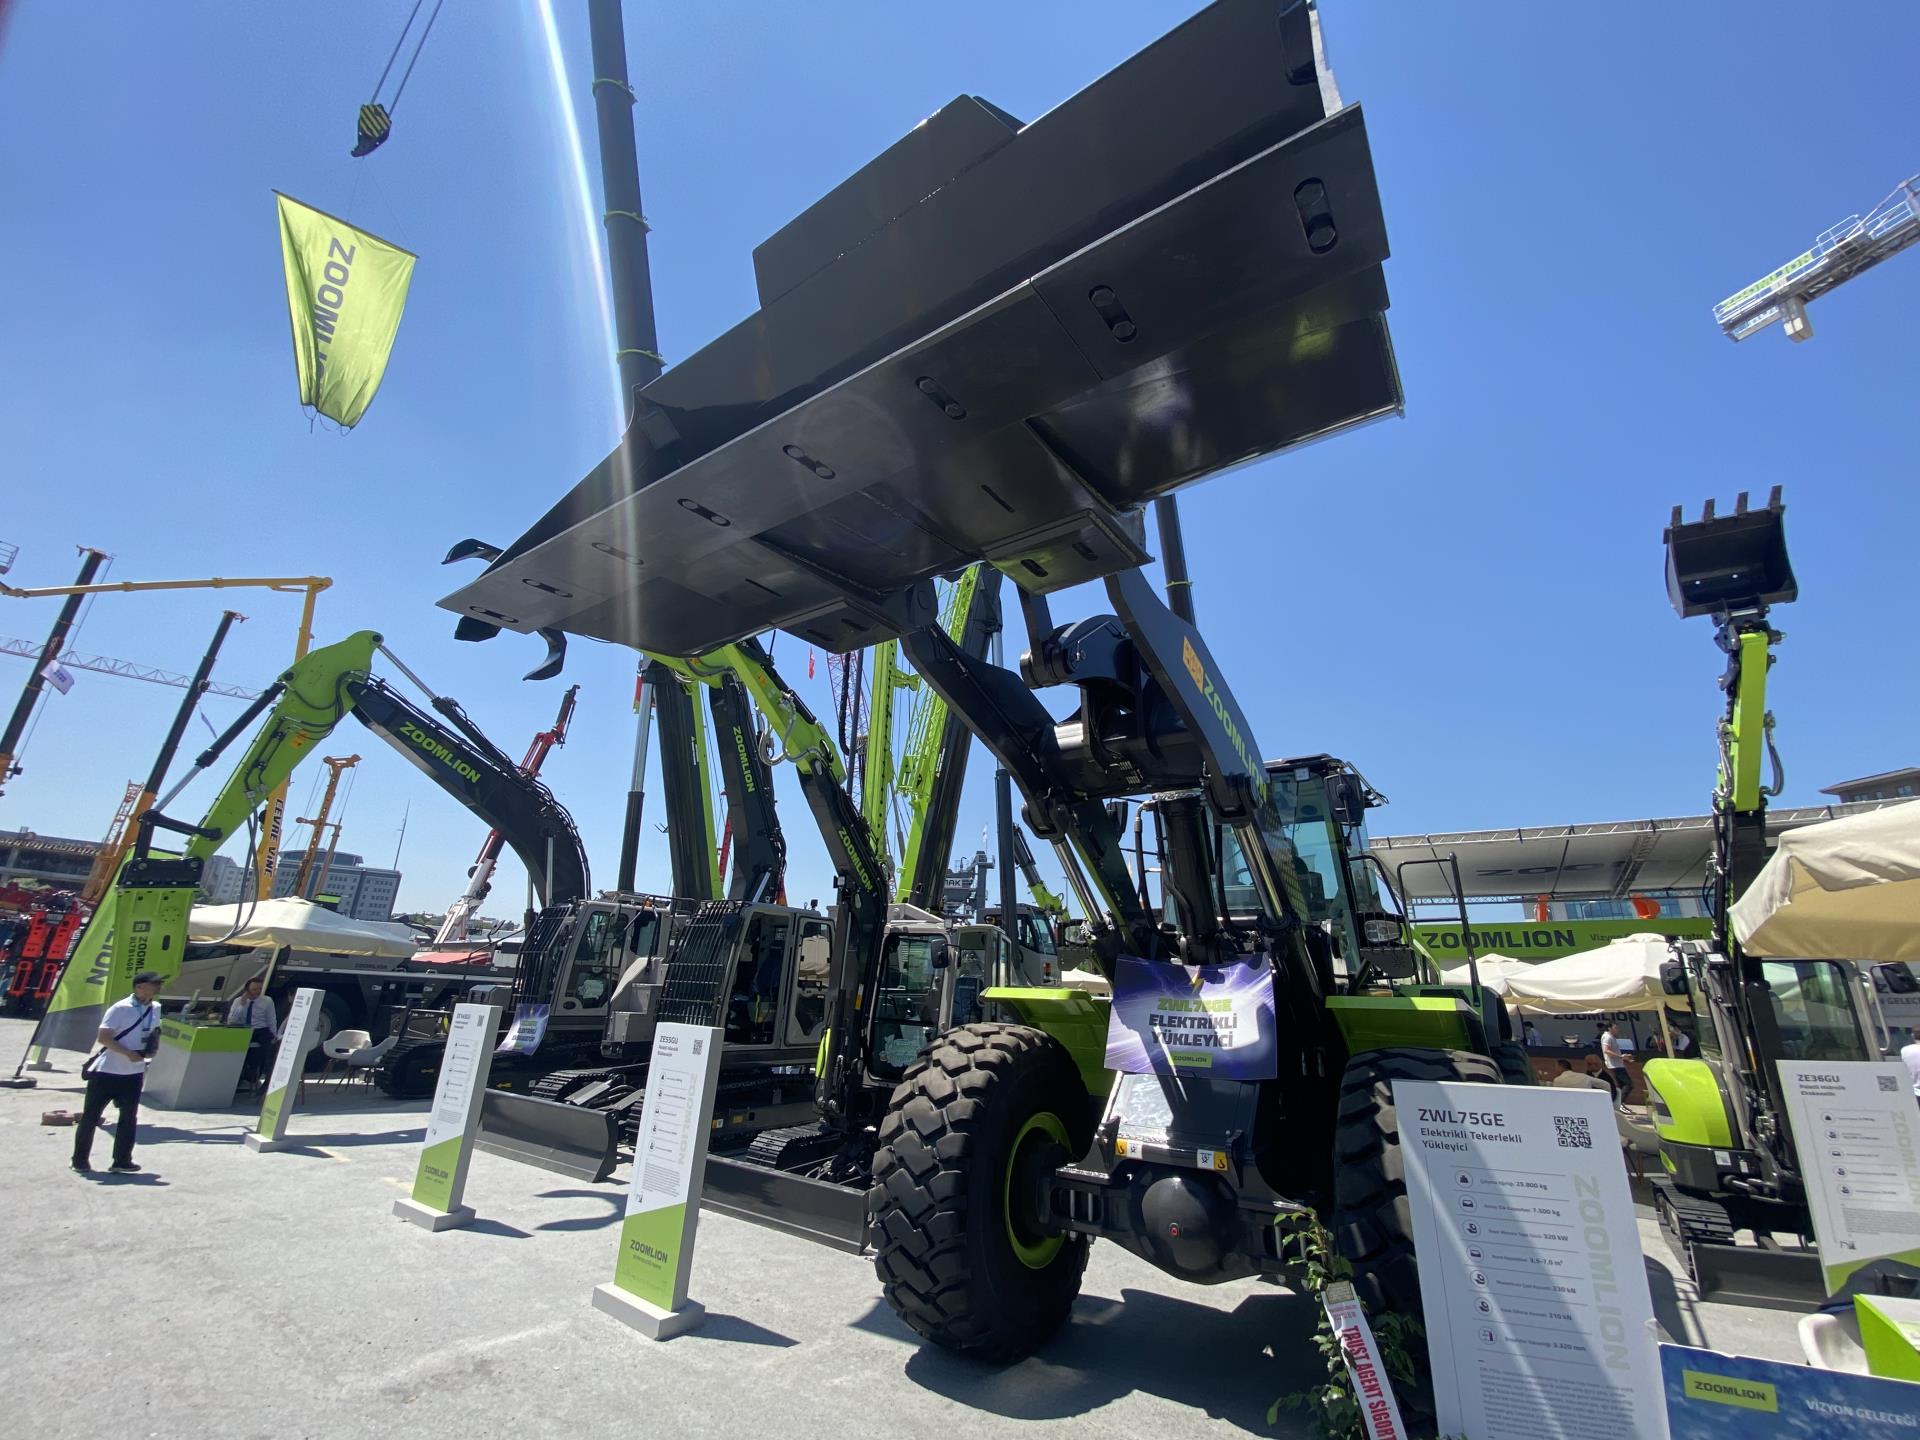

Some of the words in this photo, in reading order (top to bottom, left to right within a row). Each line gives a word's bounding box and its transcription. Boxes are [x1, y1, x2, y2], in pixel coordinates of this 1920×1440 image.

[1204, 672, 1268, 803] ZOOMLION
[399, 721, 481, 783] ZOOMLION
[732, 725, 756, 793] ZOOMLION
[838, 826, 873, 892] ZOOMLION
[1421, 929, 1576, 949] ZOOMLION
[135, 936, 149, 975] ZOOML
[1149, 1013, 1238, 1029] ELEKTRİKLİ
[1152, 1030, 1233, 1047] YÜKLEYİCİ
[1173, 1055, 1207, 1063] ZOOMLION
[1797, 1074, 1840, 1082] ZE36GU
[1418, 1108, 1505, 1127] ZWL75GE
[1420, 1128, 1467, 1139] Elektrikli
[1470, 1131, 1522, 1143] Tekerlekli
[1421, 1140, 1468, 1151] Yükleyici
[629, 1239, 668, 1263] ZOOMLION
[1573, 1173, 1632, 1371] ZOOMLION
[1342, 1325, 1371, 1360] TRUST
[1355, 1362, 1384, 1399] AGENT
[1694, 1380, 1767, 1401] ZOOMLION
[1805, 1397, 1854, 1417] VİZYON
